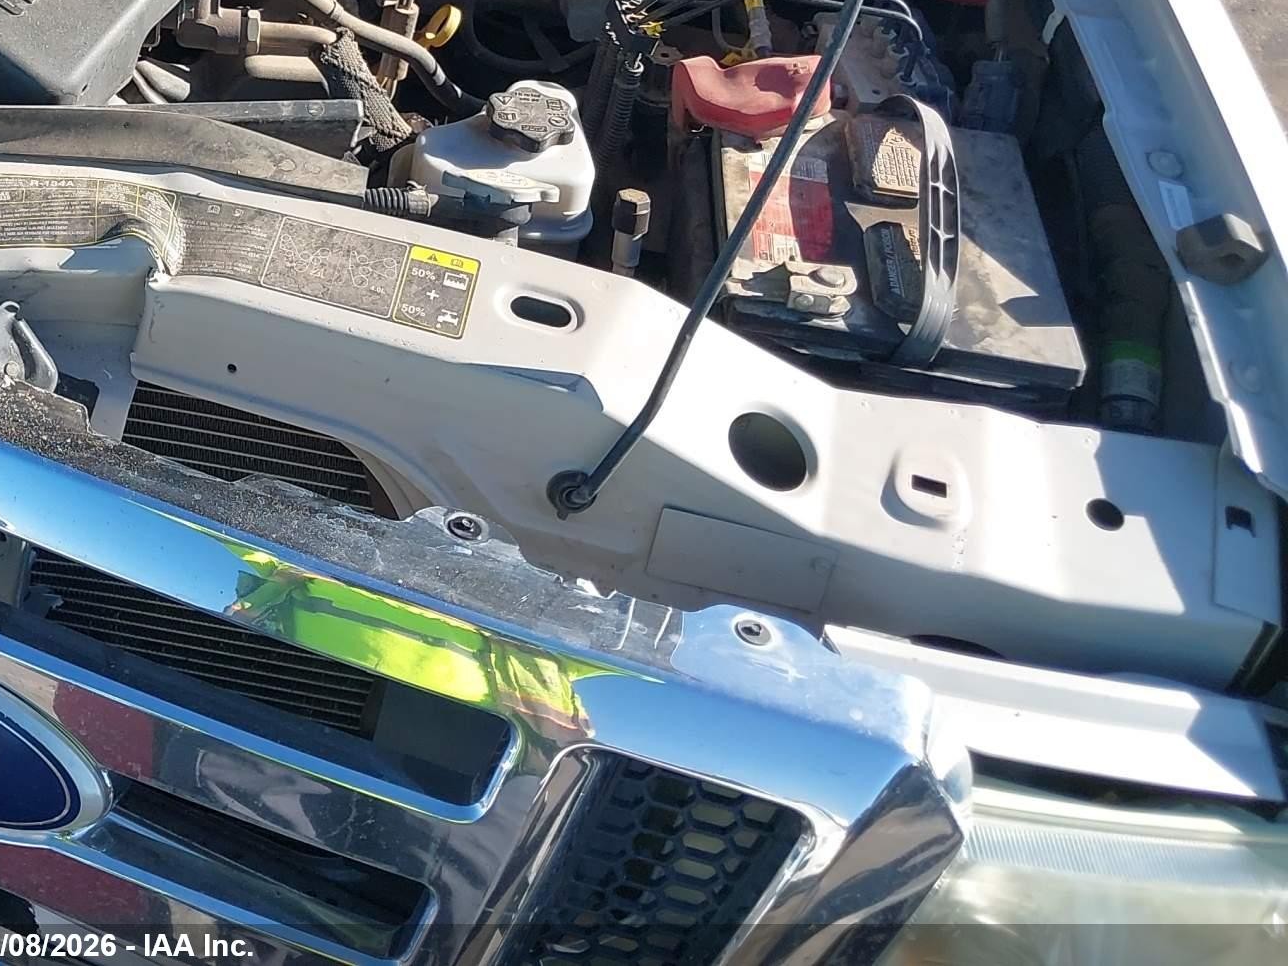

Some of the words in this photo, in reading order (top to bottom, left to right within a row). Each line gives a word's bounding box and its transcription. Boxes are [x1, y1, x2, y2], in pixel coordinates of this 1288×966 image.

[30, 179, 75, 187] R-134A
[410, 267, 436, 281] 50%
[400, 303, 426, 317] 50%
